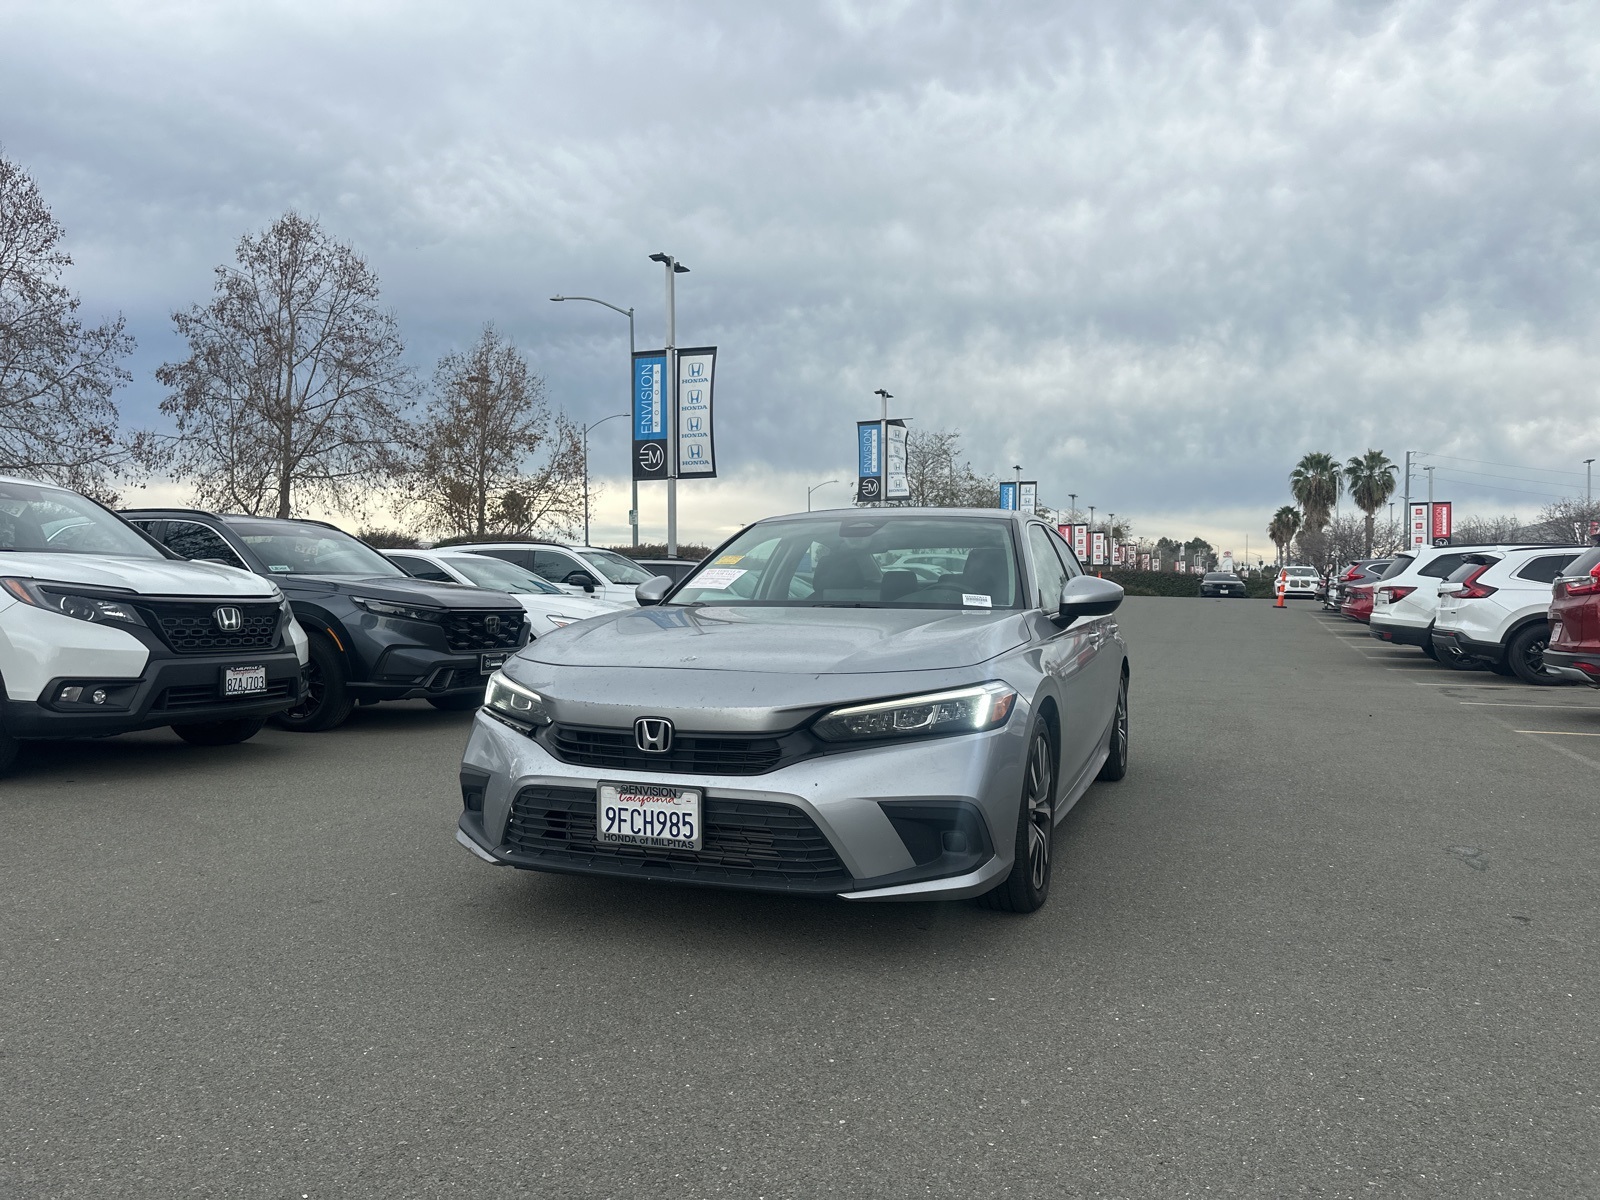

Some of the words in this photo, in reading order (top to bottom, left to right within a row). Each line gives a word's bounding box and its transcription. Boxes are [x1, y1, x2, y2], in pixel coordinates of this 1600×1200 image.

[641, 364, 653, 434] ENVISION
[863, 429, 872, 473] ENVISION
[227, 676, 265, 692] 8ZAJ703
[629, 785, 677, 797] ENVISION
[619, 793, 681, 807] California
[605, 806, 694, 839] 9FCH985
[603, 833, 638, 844] HONDA
[651, 838, 695, 849] MILPITAS
